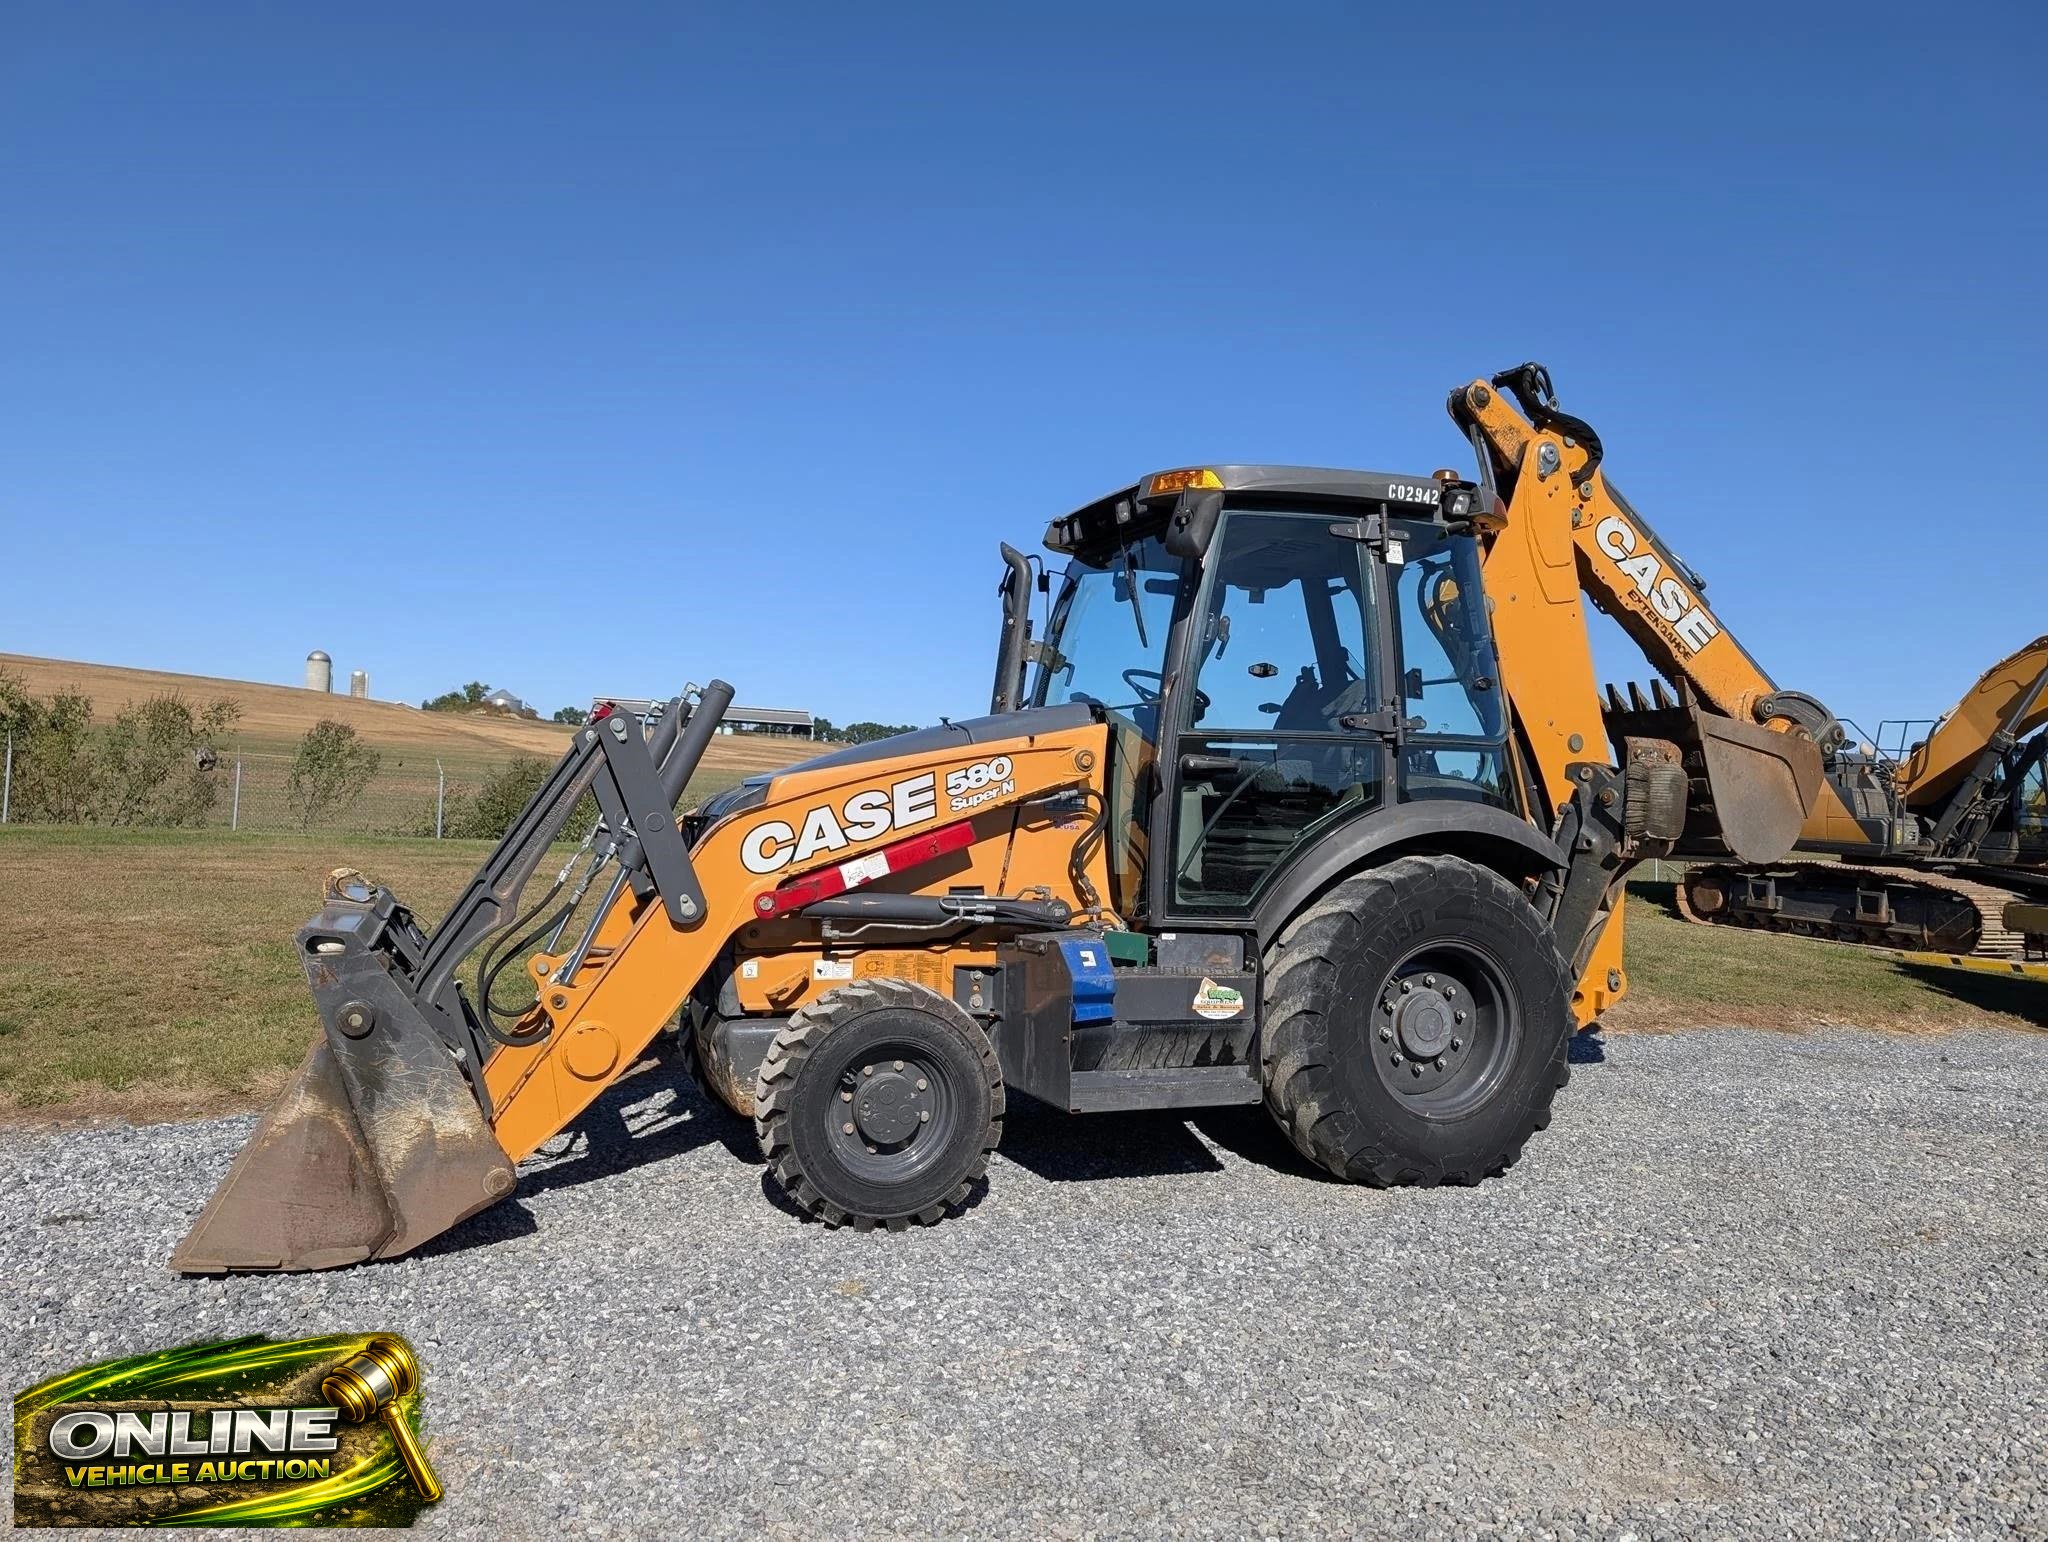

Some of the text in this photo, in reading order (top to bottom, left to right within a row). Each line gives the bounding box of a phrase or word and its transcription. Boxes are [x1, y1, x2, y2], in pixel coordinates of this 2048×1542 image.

[1595, 516, 1720, 654] CASE
[945, 756, 1013, 796] 580
[950, 778, 1016, 812] Super N
[740, 771, 937, 875] CASE
